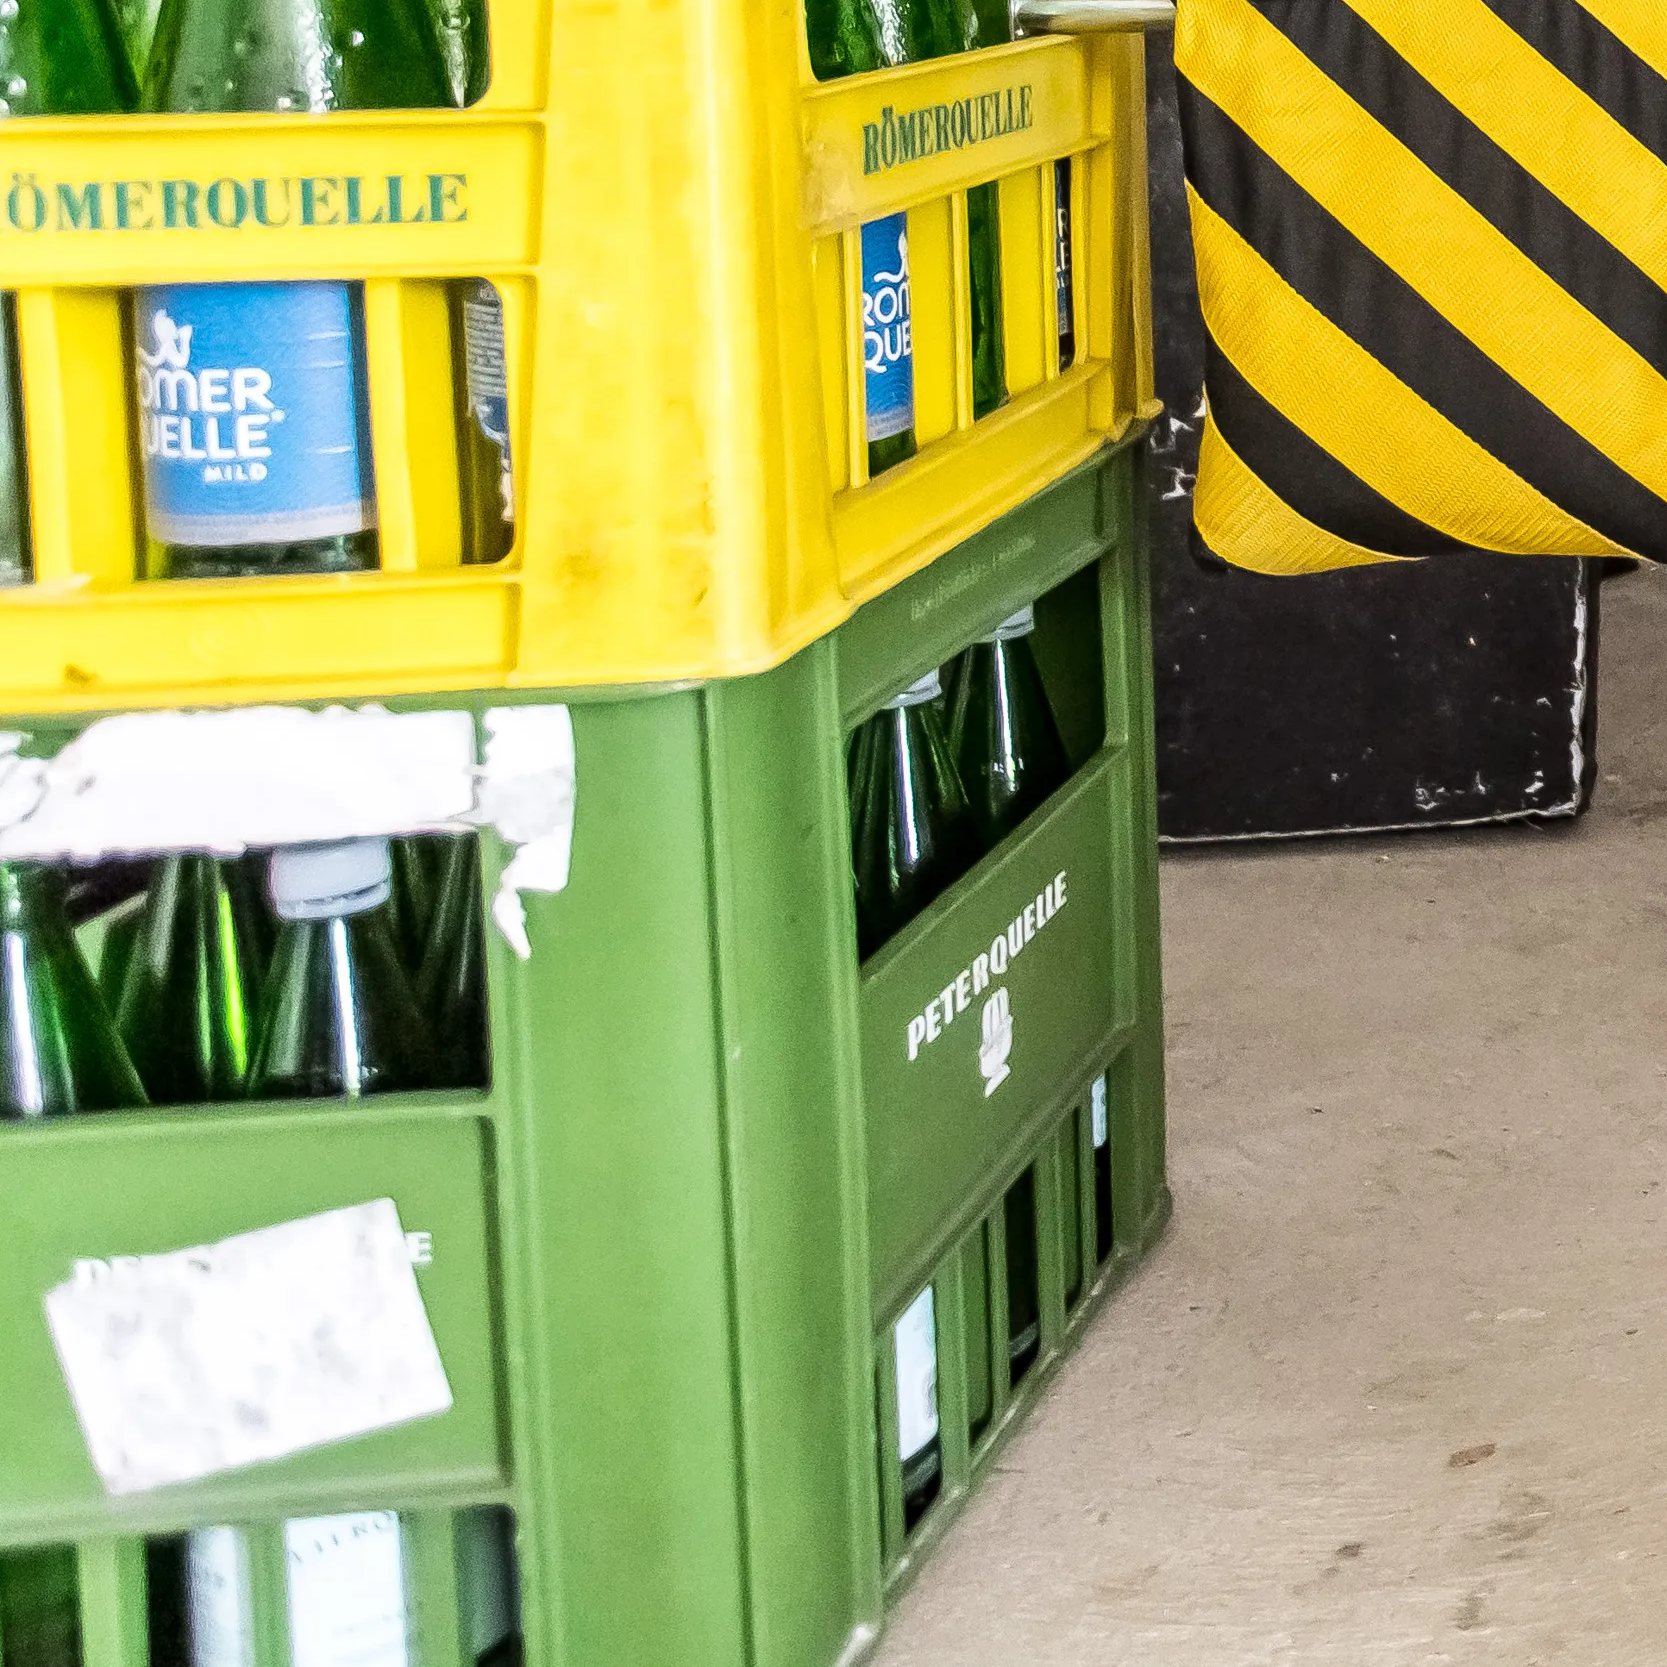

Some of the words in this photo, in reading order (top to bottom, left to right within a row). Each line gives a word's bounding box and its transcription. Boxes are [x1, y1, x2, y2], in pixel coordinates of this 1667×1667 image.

[862, 84, 1034, 176] RÖMERQUELLE
[5, 171, 469, 234] ÖMERQUELLE
[203, 462, 269, 483] MILD
[907, 869, 1068, 1062] PETERQUELLE
